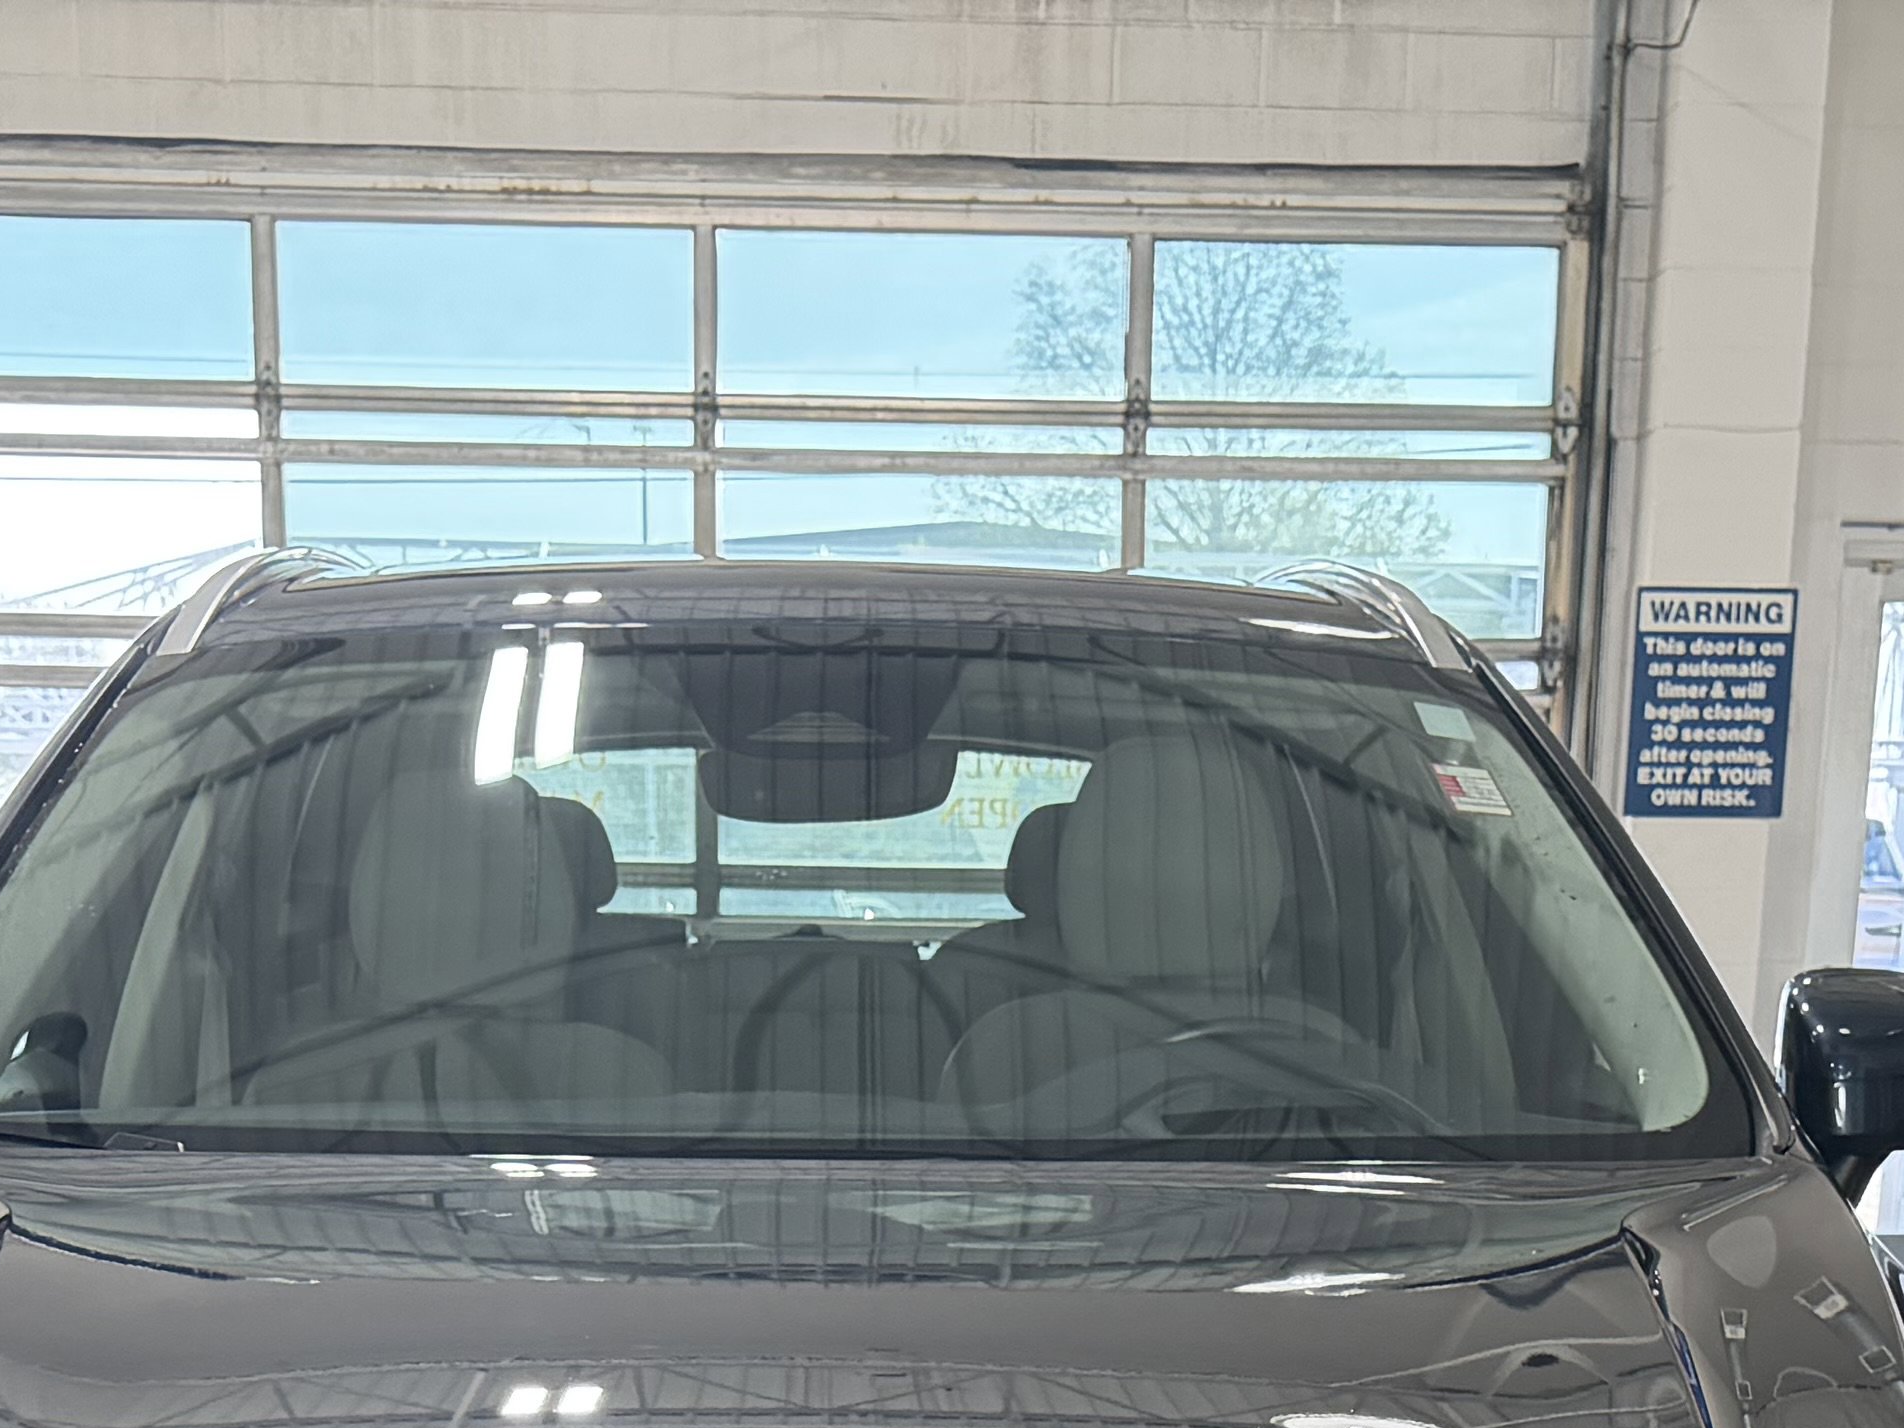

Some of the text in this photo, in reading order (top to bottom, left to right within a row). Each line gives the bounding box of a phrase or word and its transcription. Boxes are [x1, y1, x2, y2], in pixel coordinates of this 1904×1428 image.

[1651, 600, 1784, 624] WARNING
[1643, 637, 1785, 656] This door is on
[1648, 660, 1776, 678] an automatic
[1656, 680, 1767, 699] timer & will
[1644, 702, 1775, 724] begin closing
[1650, 724, 1765, 743] 30 seconds
[1639, 747, 1687, 763] after
[1637, 767, 1773, 785] EXIT AT YOUR
[1650, 788, 1756, 806] OWN RISK.
